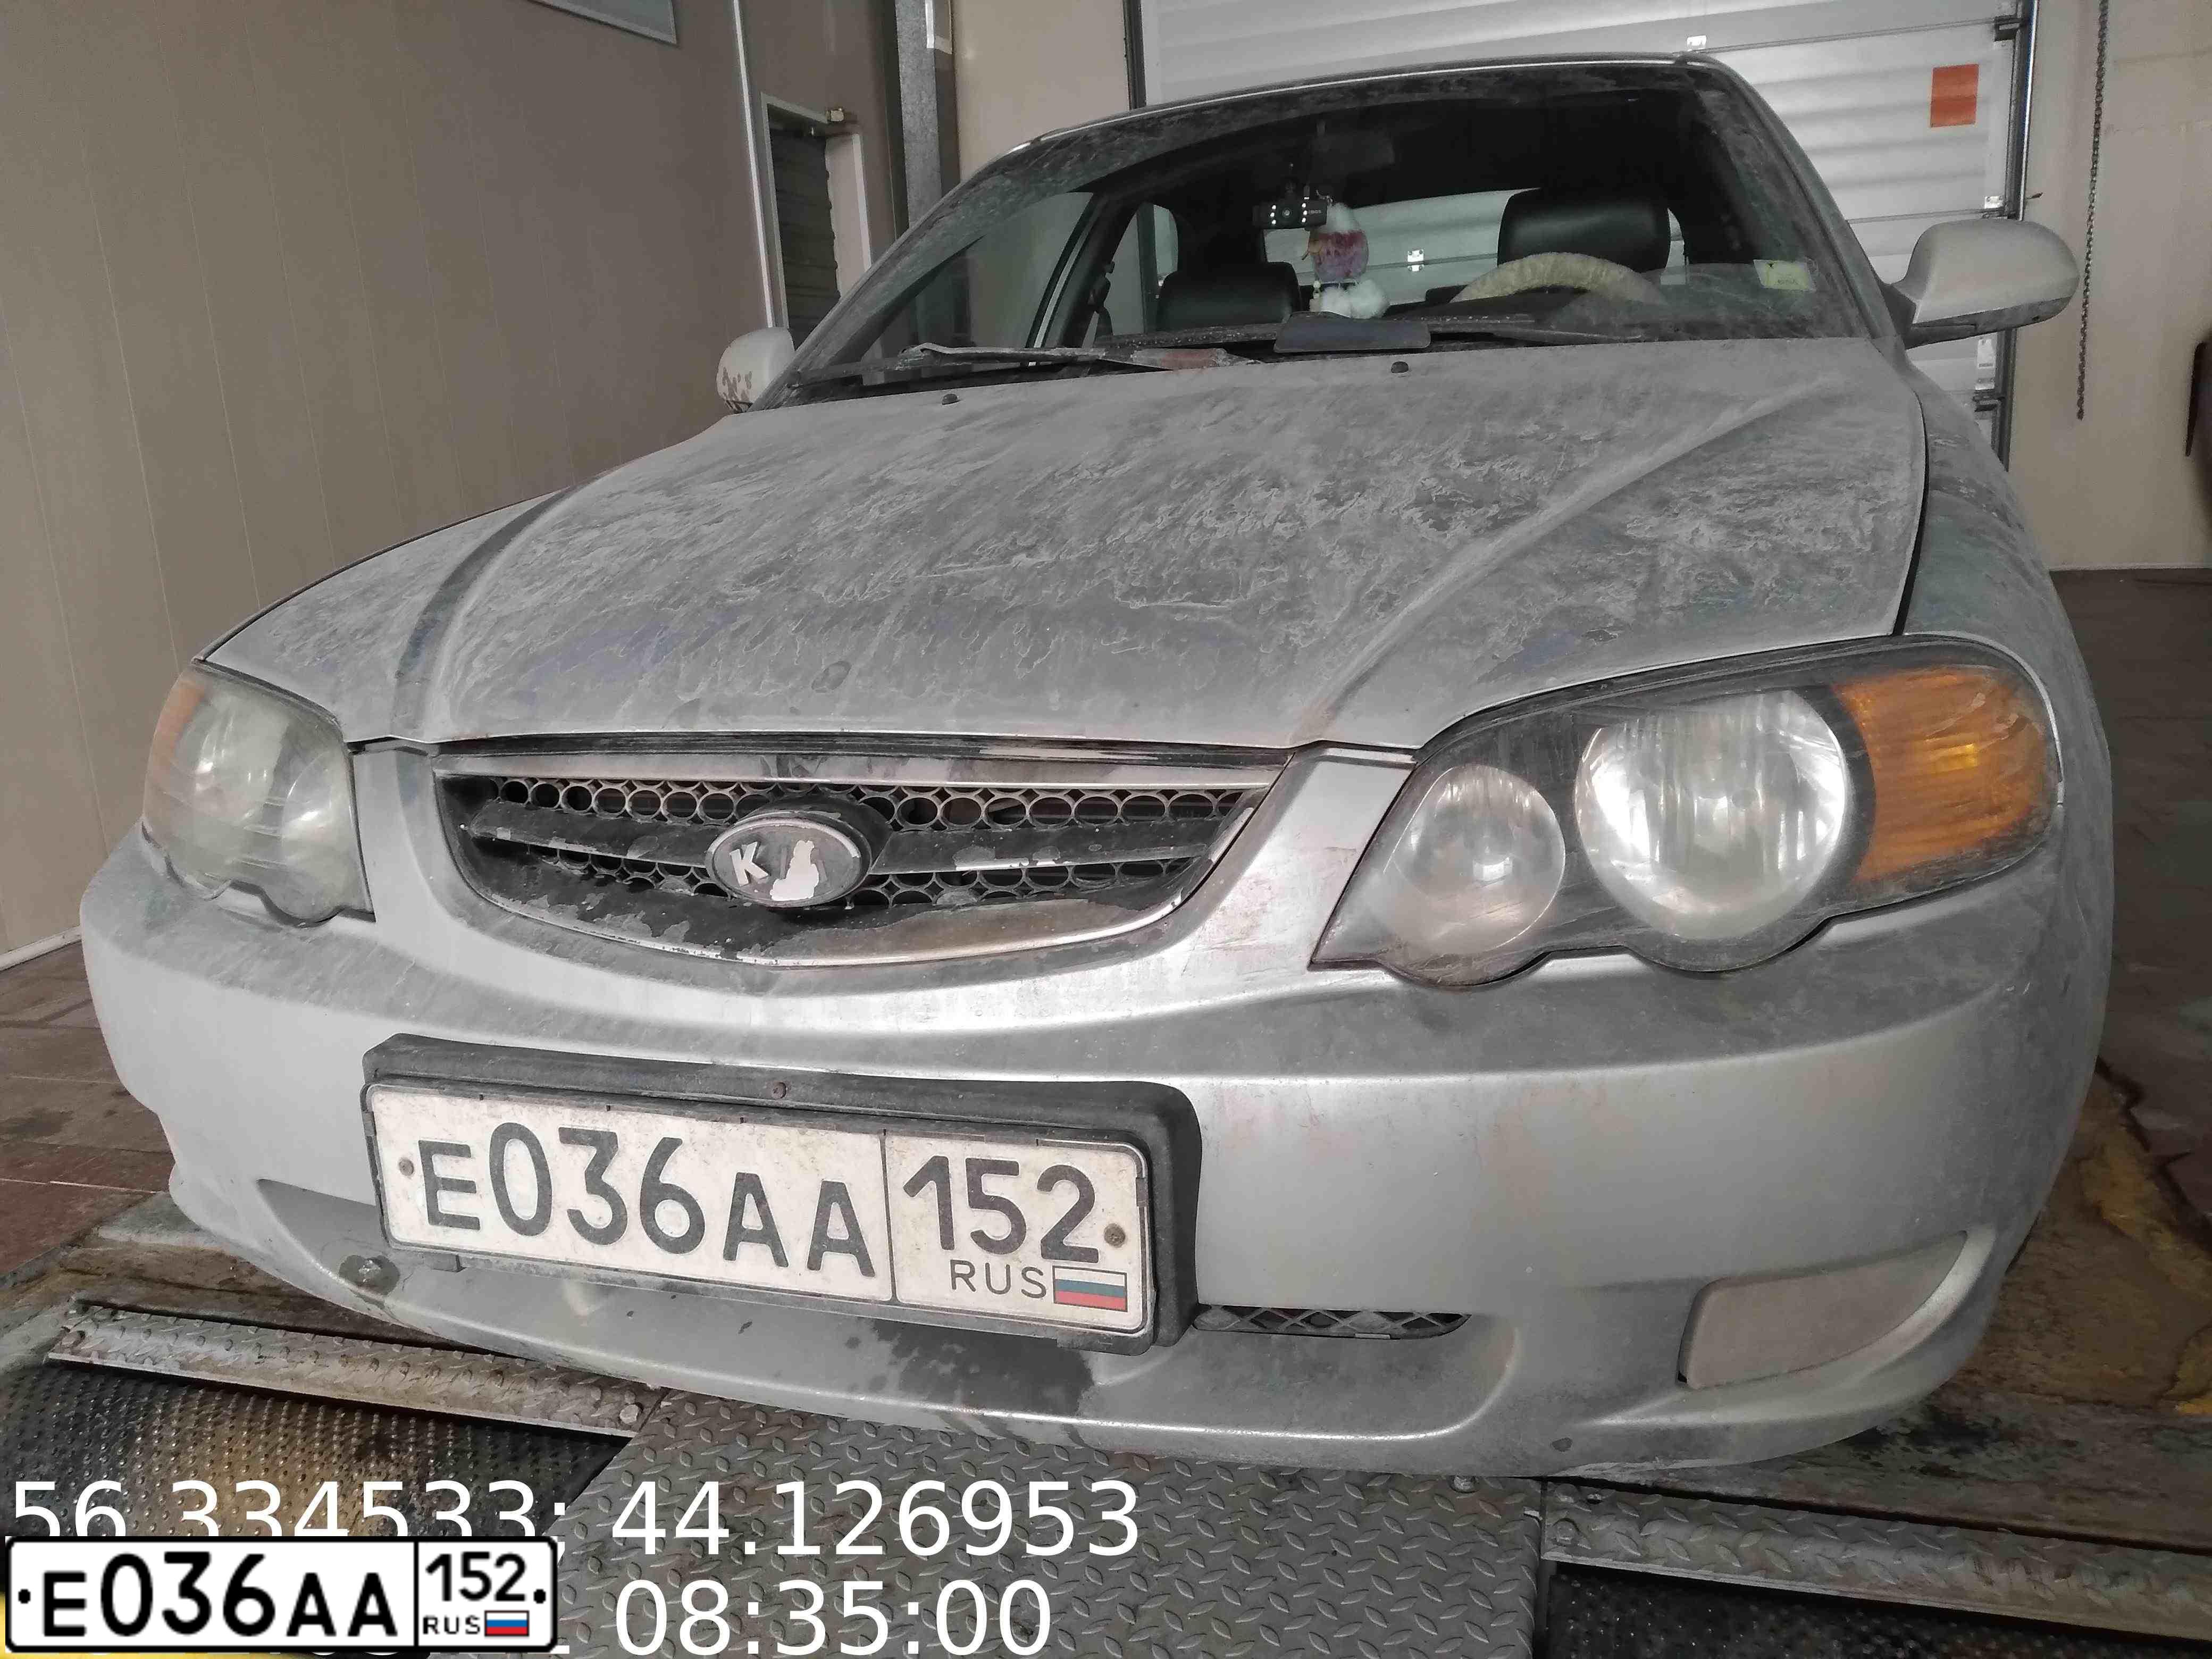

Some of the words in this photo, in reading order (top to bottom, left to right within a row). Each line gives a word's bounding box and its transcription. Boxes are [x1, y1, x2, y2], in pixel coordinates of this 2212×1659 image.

[416, 1121, 877, 1278] E036AA
[902, 1154, 1100, 1264] 152
[950, 1259, 1047, 1300] RUS
